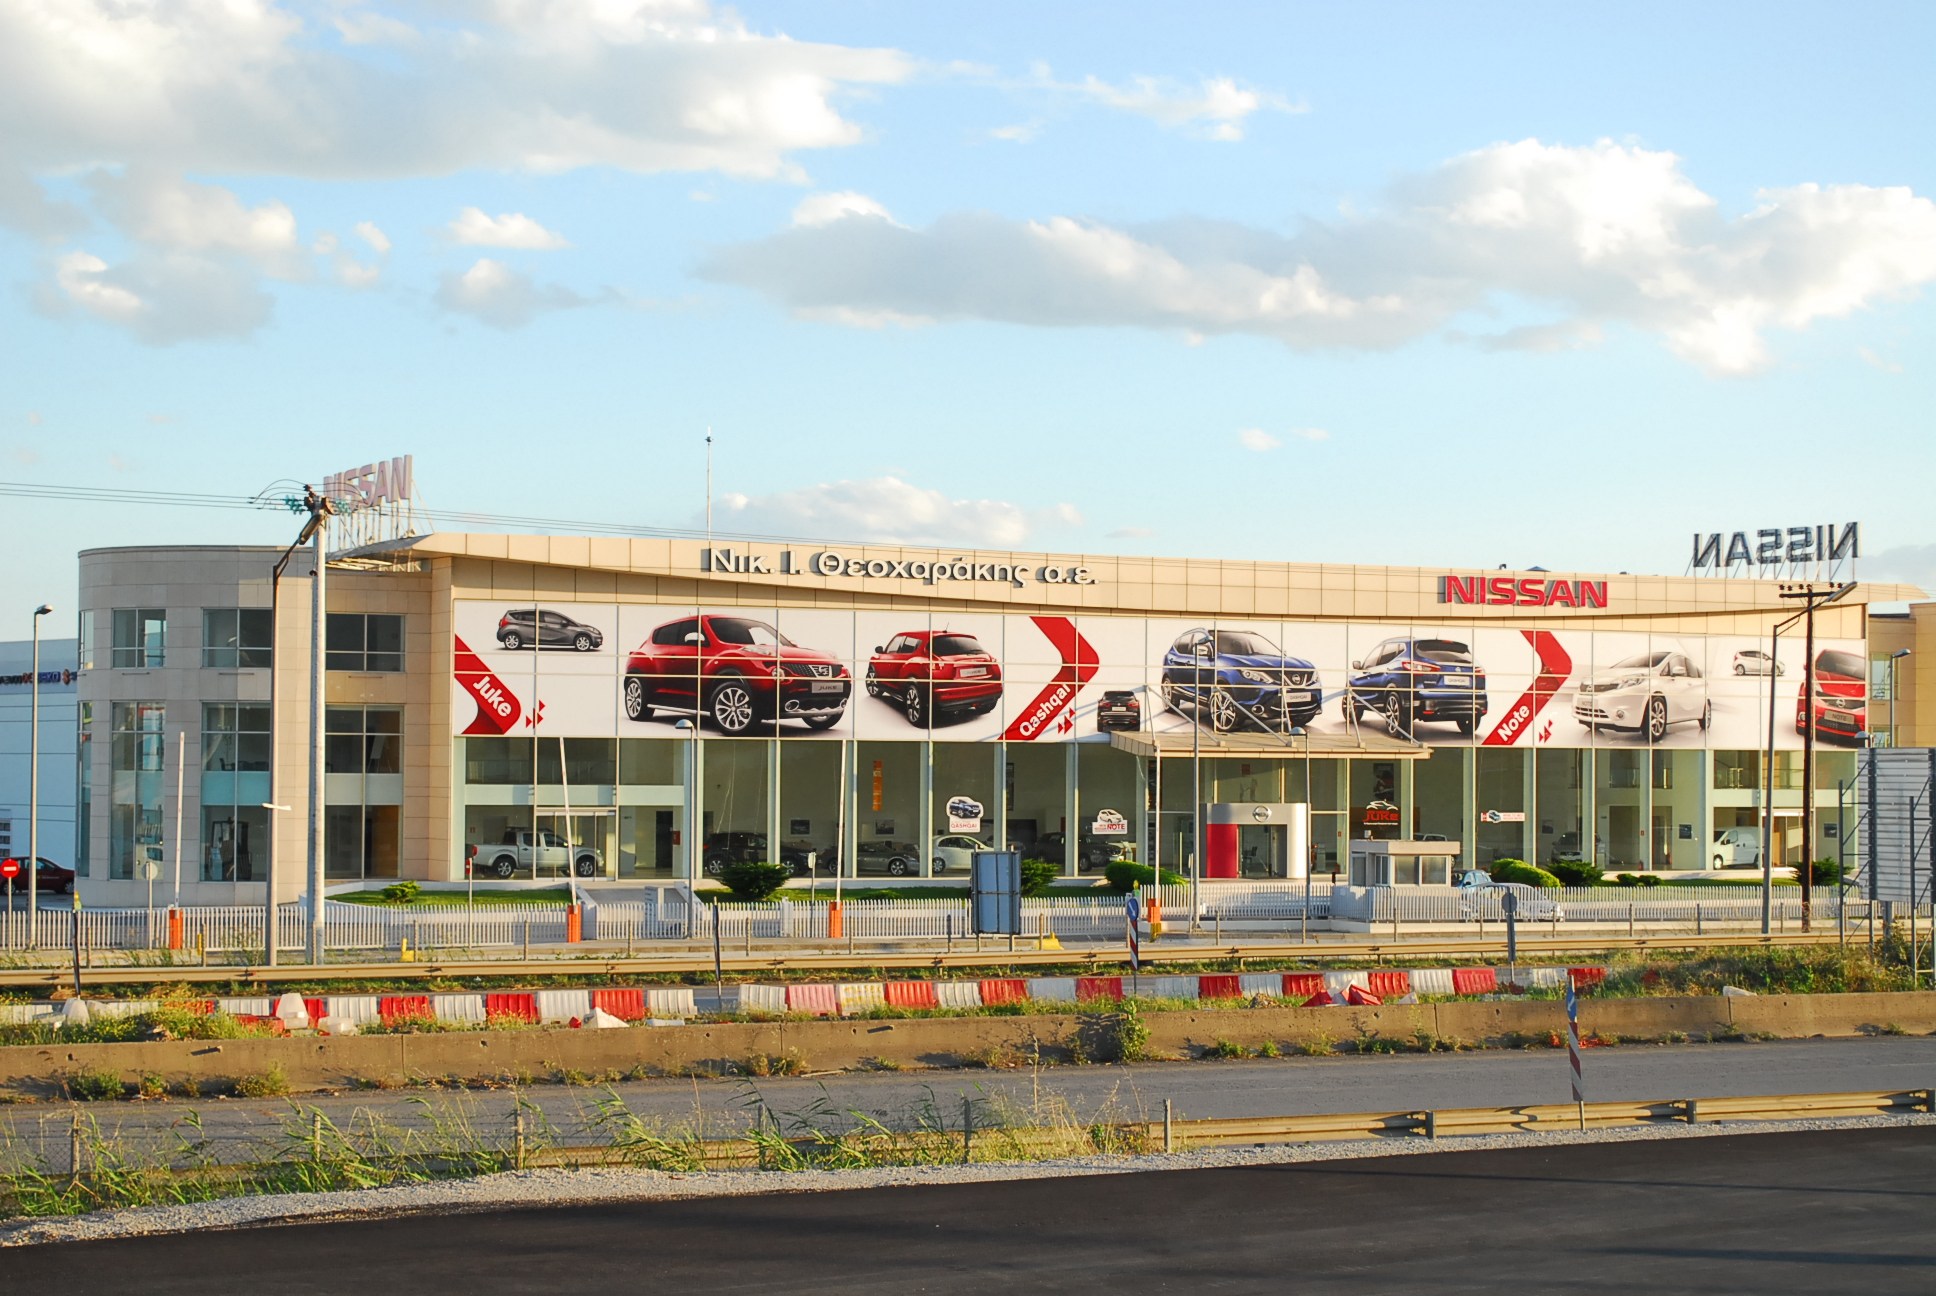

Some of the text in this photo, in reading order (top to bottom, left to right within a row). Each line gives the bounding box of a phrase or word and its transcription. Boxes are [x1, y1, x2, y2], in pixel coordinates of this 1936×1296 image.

[710, 548, 776, 574] Νικ.
[817, 551, 1030, 588] Θεοχαράκης
[1043, 564, 1100, 585] α.ε.
[1445, 575, 1608, 608] NISSAN
[472, 675, 512, 717] Juke
[1019, 683, 1071, 737] Qashqai
[1496, 705, 1530, 742] Note
